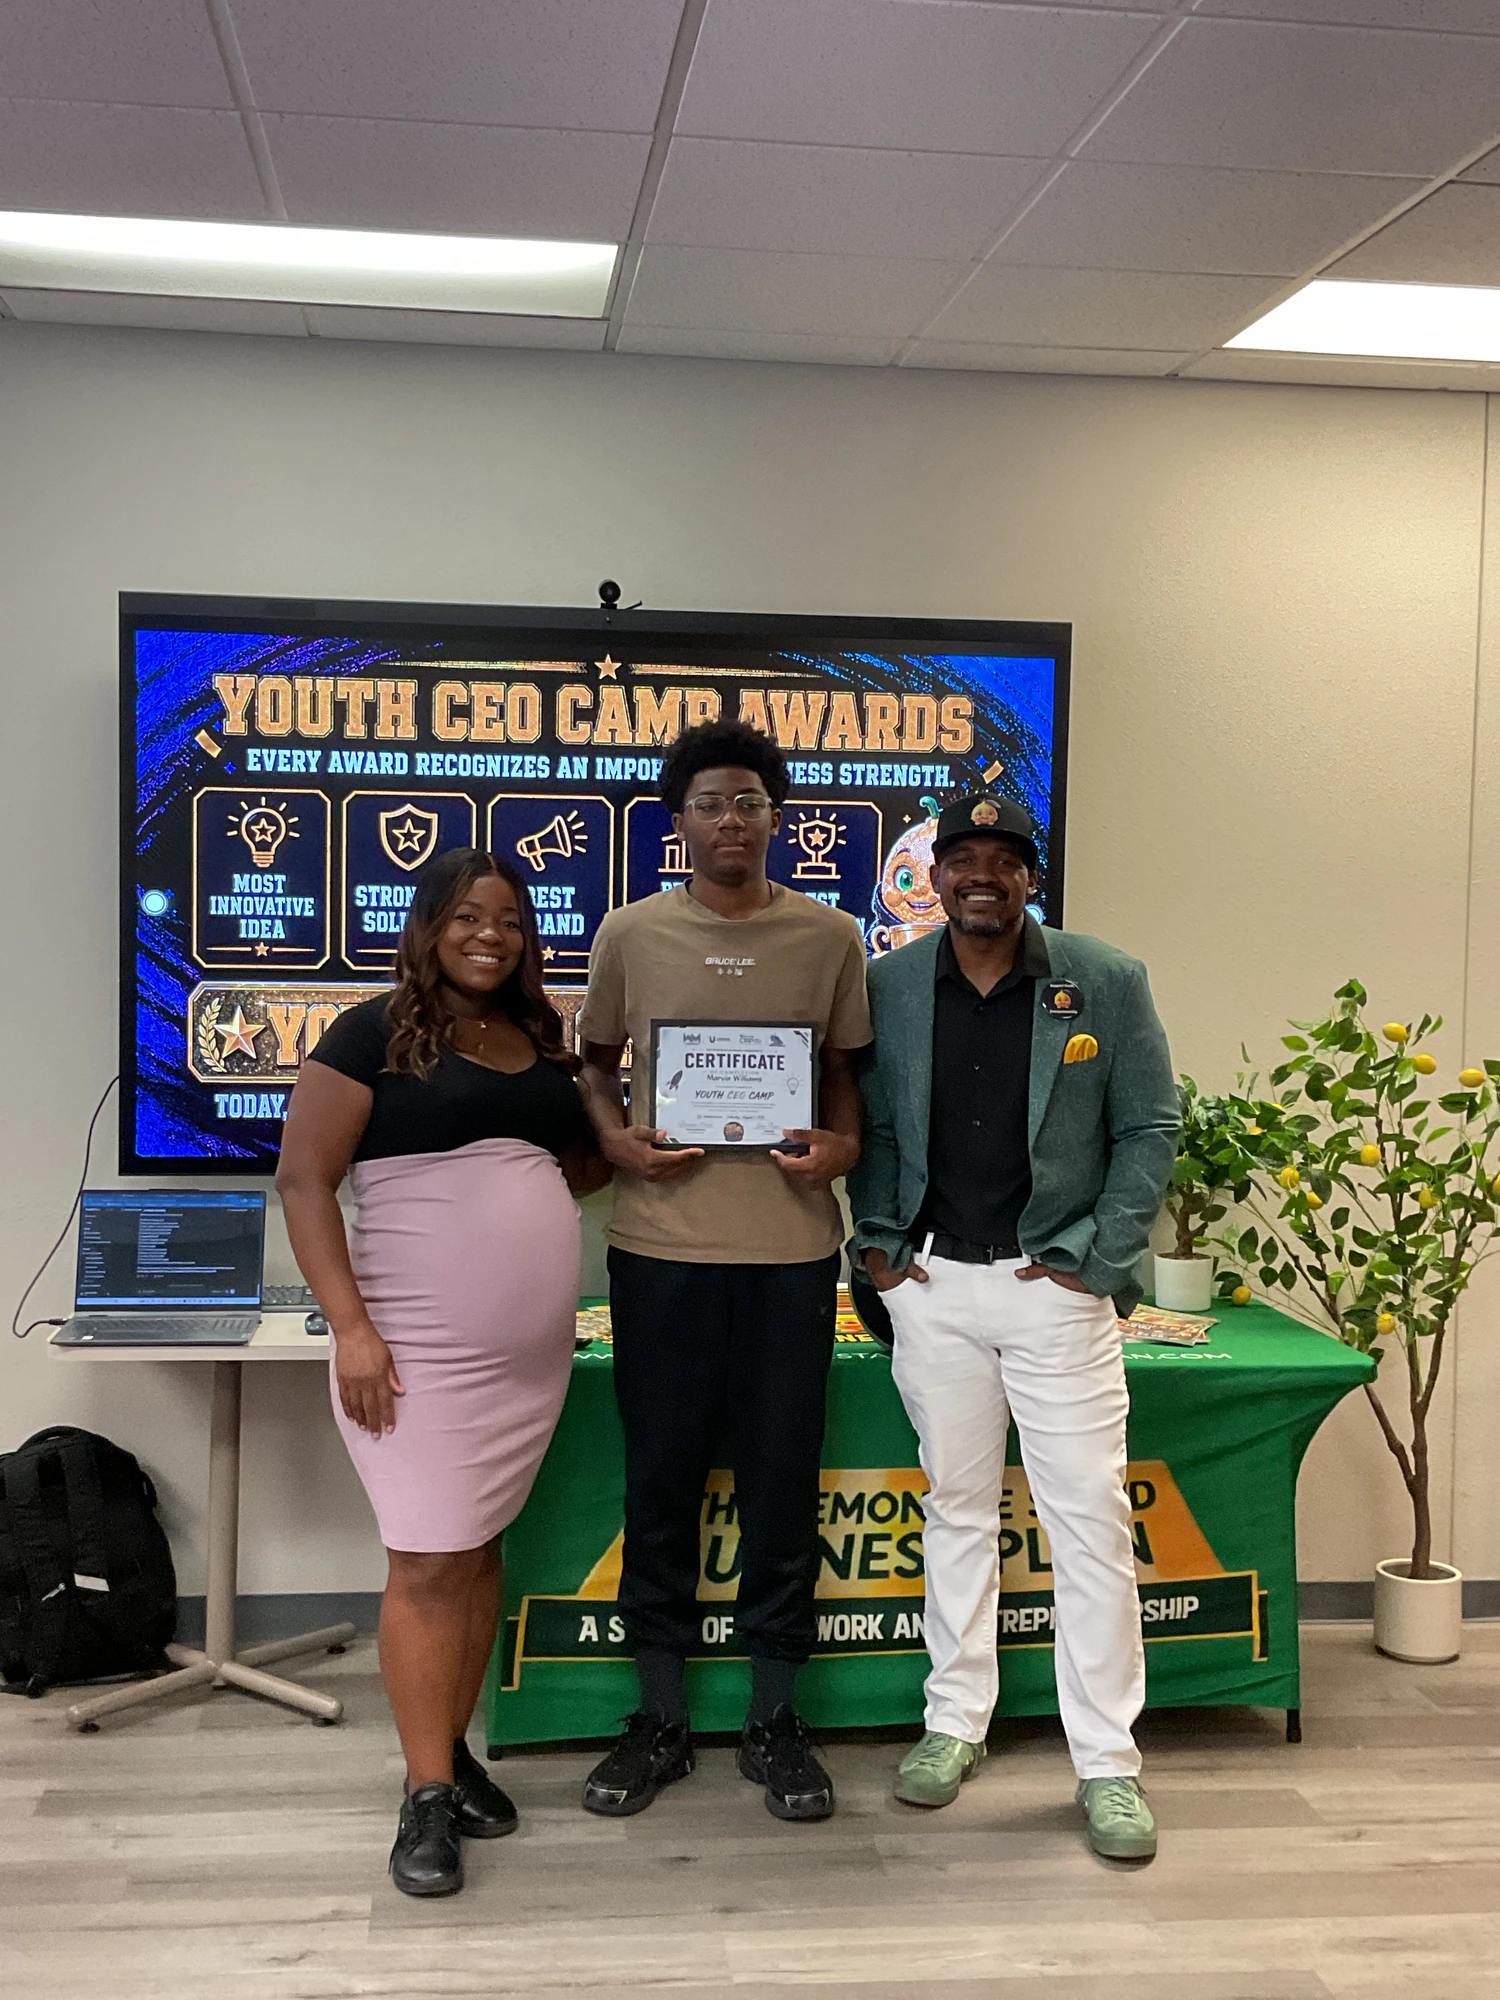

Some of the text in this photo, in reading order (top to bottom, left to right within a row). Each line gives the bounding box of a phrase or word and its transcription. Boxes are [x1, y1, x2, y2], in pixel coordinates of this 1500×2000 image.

[213, 674, 975, 754] YOUTH CEO CAMP AWARDS
[247, 748, 322, 773] EVERY
[327, 750, 409, 775] AWARD
[415, 752, 550, 778] RECOGNIZES
[556, 756, 588, 779] AN
[839, 762, 956, 787] STRENGTH.
[233, 874, 287, 894] MOST
[209, 895, 315, 917] INNOVATIVE
[239, 918, 286, 939] IDEA
[704, 957, 736, 966] BRUCE
[685, 1053, 785, 1071] CERTIFICATE
[695, 1090, 774, 1101] YOUTH CEO CAMP
[215, 1094, 288, 1121] TODAY,
[578, 1615, 599, 1642] A
[702, 1616, 735, 1643] OF
[816, 1613, 885, 1642] WORK
[893, 1611, 925, 1640] AN
